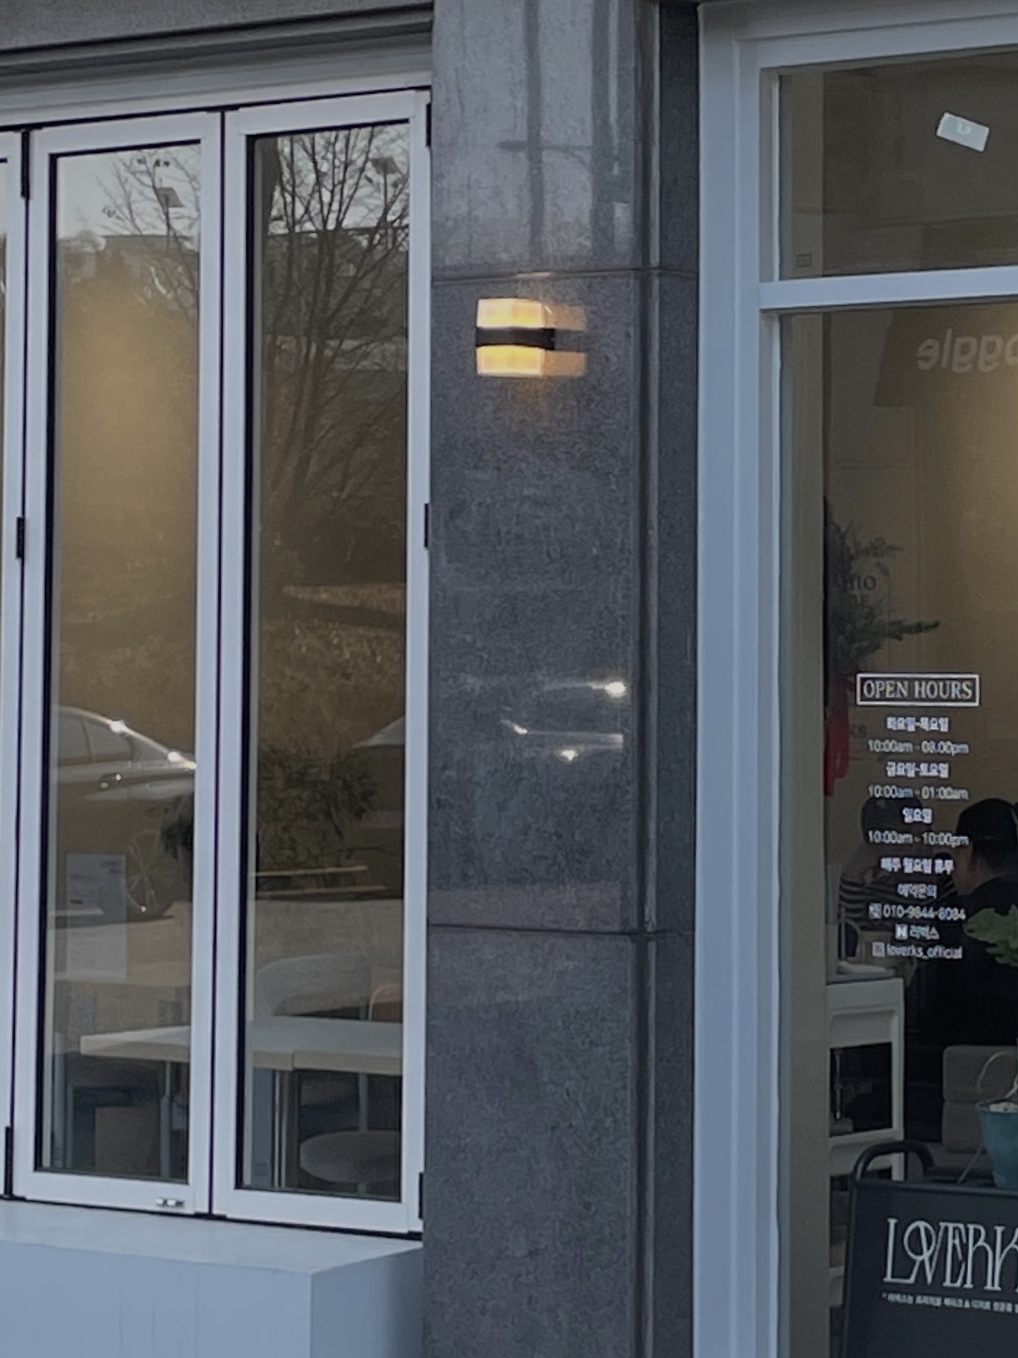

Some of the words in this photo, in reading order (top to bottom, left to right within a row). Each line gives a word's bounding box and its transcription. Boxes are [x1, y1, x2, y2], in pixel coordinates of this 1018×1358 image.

[862, 680, 908, 699] OPEN
[913, 680, 973, 699] HOURS
[868, 785, 913, 798] 10:00am
